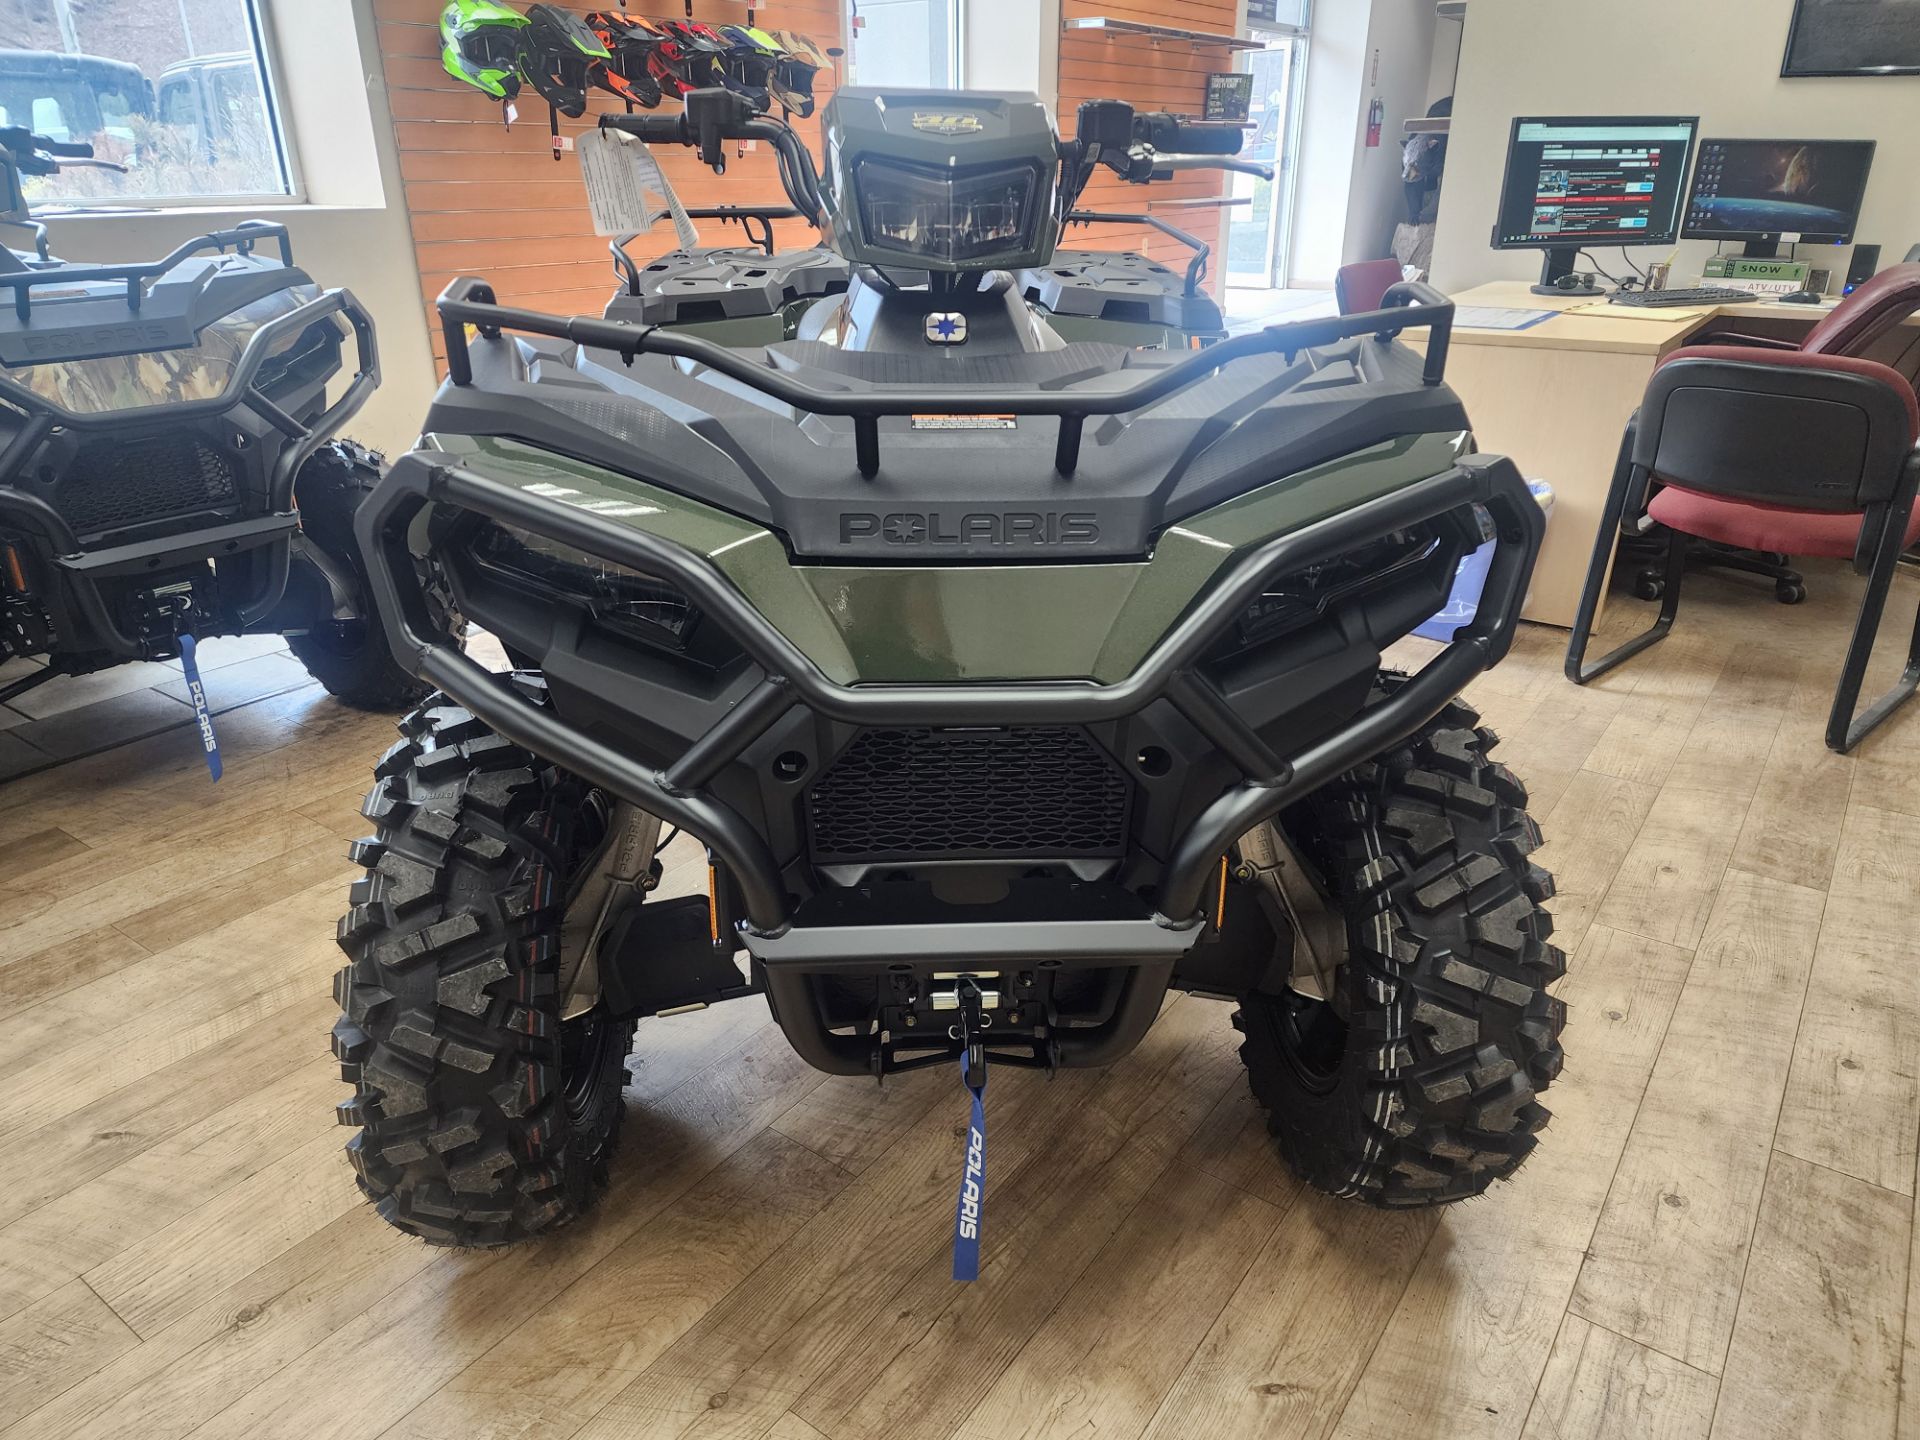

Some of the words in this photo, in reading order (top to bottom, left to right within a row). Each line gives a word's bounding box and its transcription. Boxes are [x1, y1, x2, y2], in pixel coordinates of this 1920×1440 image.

[1740, 265, 1781, 273] SNOW
[1747, 283, 1796, 292] ATV/UTV
[22, 325, 169, 354] POLARIS
[840, 513, 1100, 545] POLARIS
[190, 680, 216, 753] POLARIS
[959, 1126, 983, 1239] POLARIS
